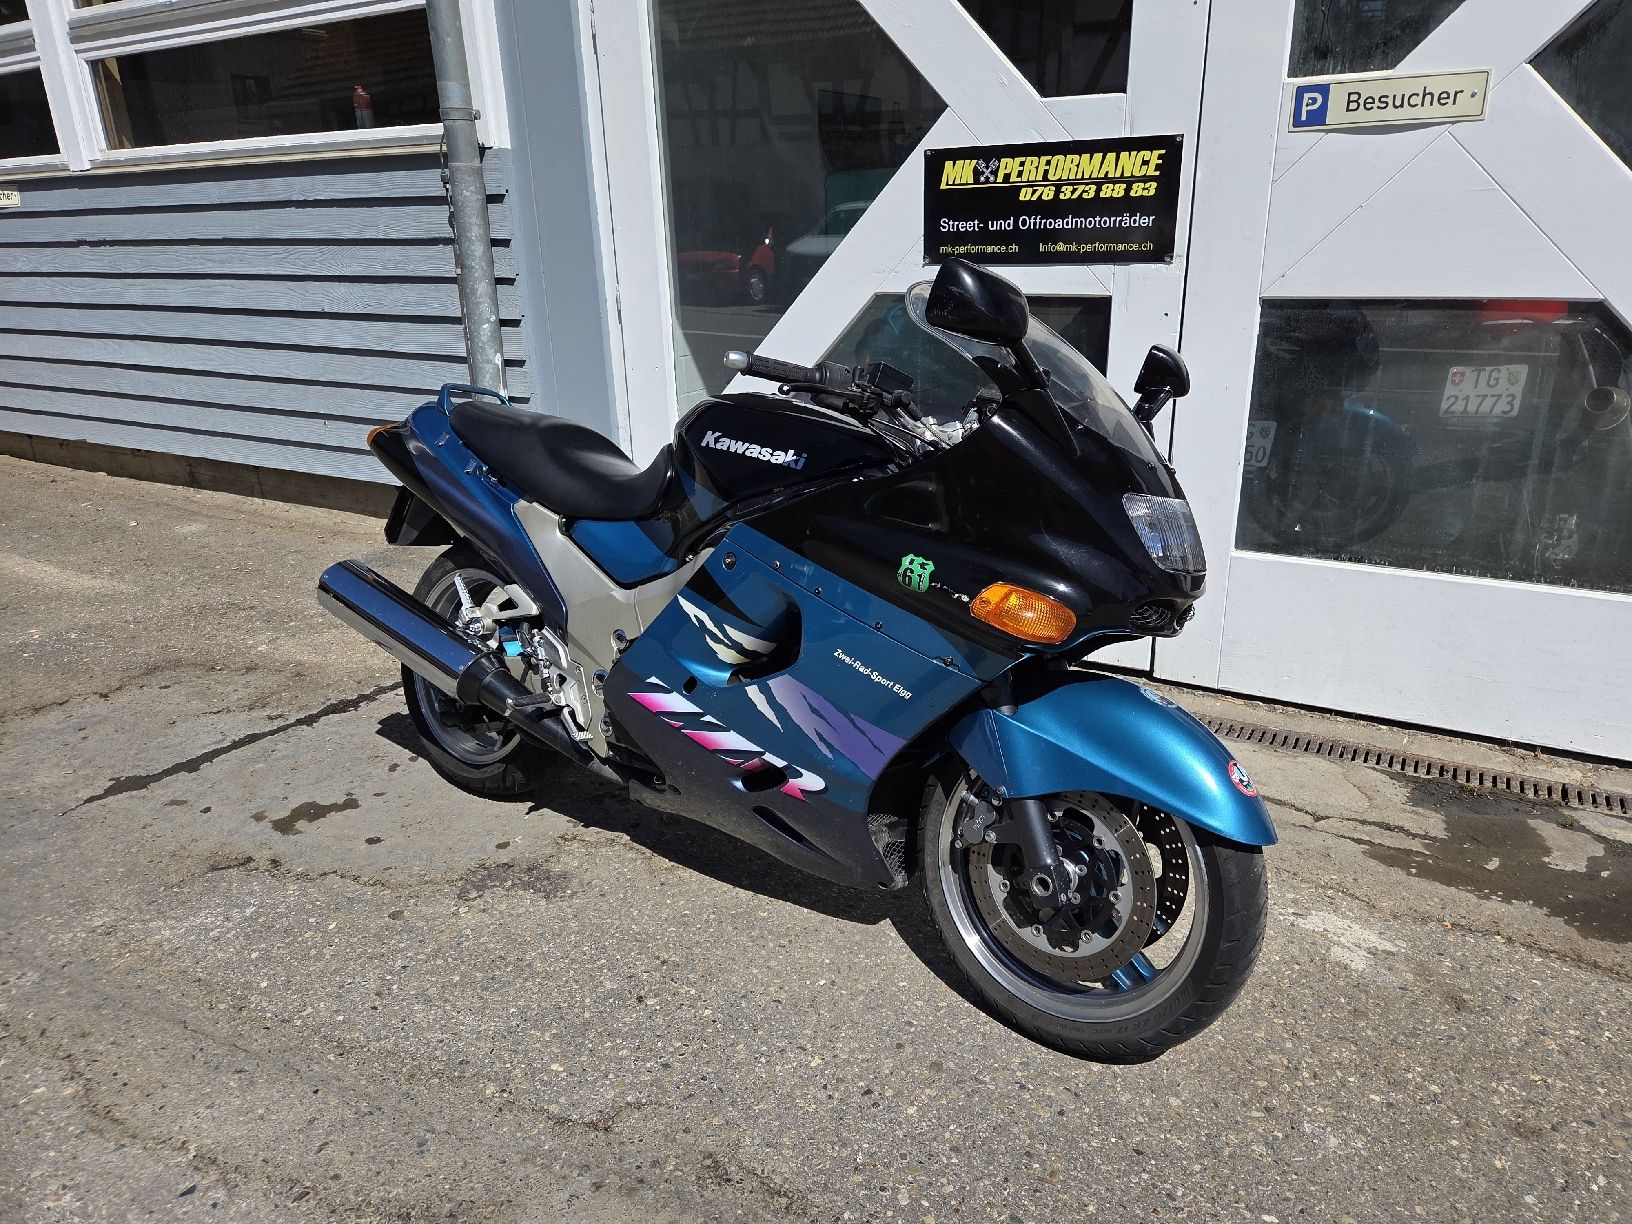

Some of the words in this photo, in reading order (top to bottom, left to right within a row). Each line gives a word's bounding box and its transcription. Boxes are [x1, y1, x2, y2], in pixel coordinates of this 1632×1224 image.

[1345, 86, 1464, 113] Besucher
[940, 159, 978, 188] MK
[996, 149, 1167, 183] PERFORMANCE
[1019, 186, 1055, 201] 076
[1059, 184, 1097, 199] 373
[1100, 182, 1127, 198] 88
[1130, 181, 1157, 197] 83
[940, 217, 984, 232] Street-
[988, 216, 1014, 231] und
[1018, 212, 1155, 230] Offroadmotorräder
[940, 243, 1019, 255] mk-performance.ch
[1471, 367, 1502, 389] TG
[1443, 393, 1517, 415] 21773
[701, 430, 808, 470] Kawasaki
[833, 648, 894, 689] Zwei-Rad-Sport
[892, 684, 913, 700] Elgg
